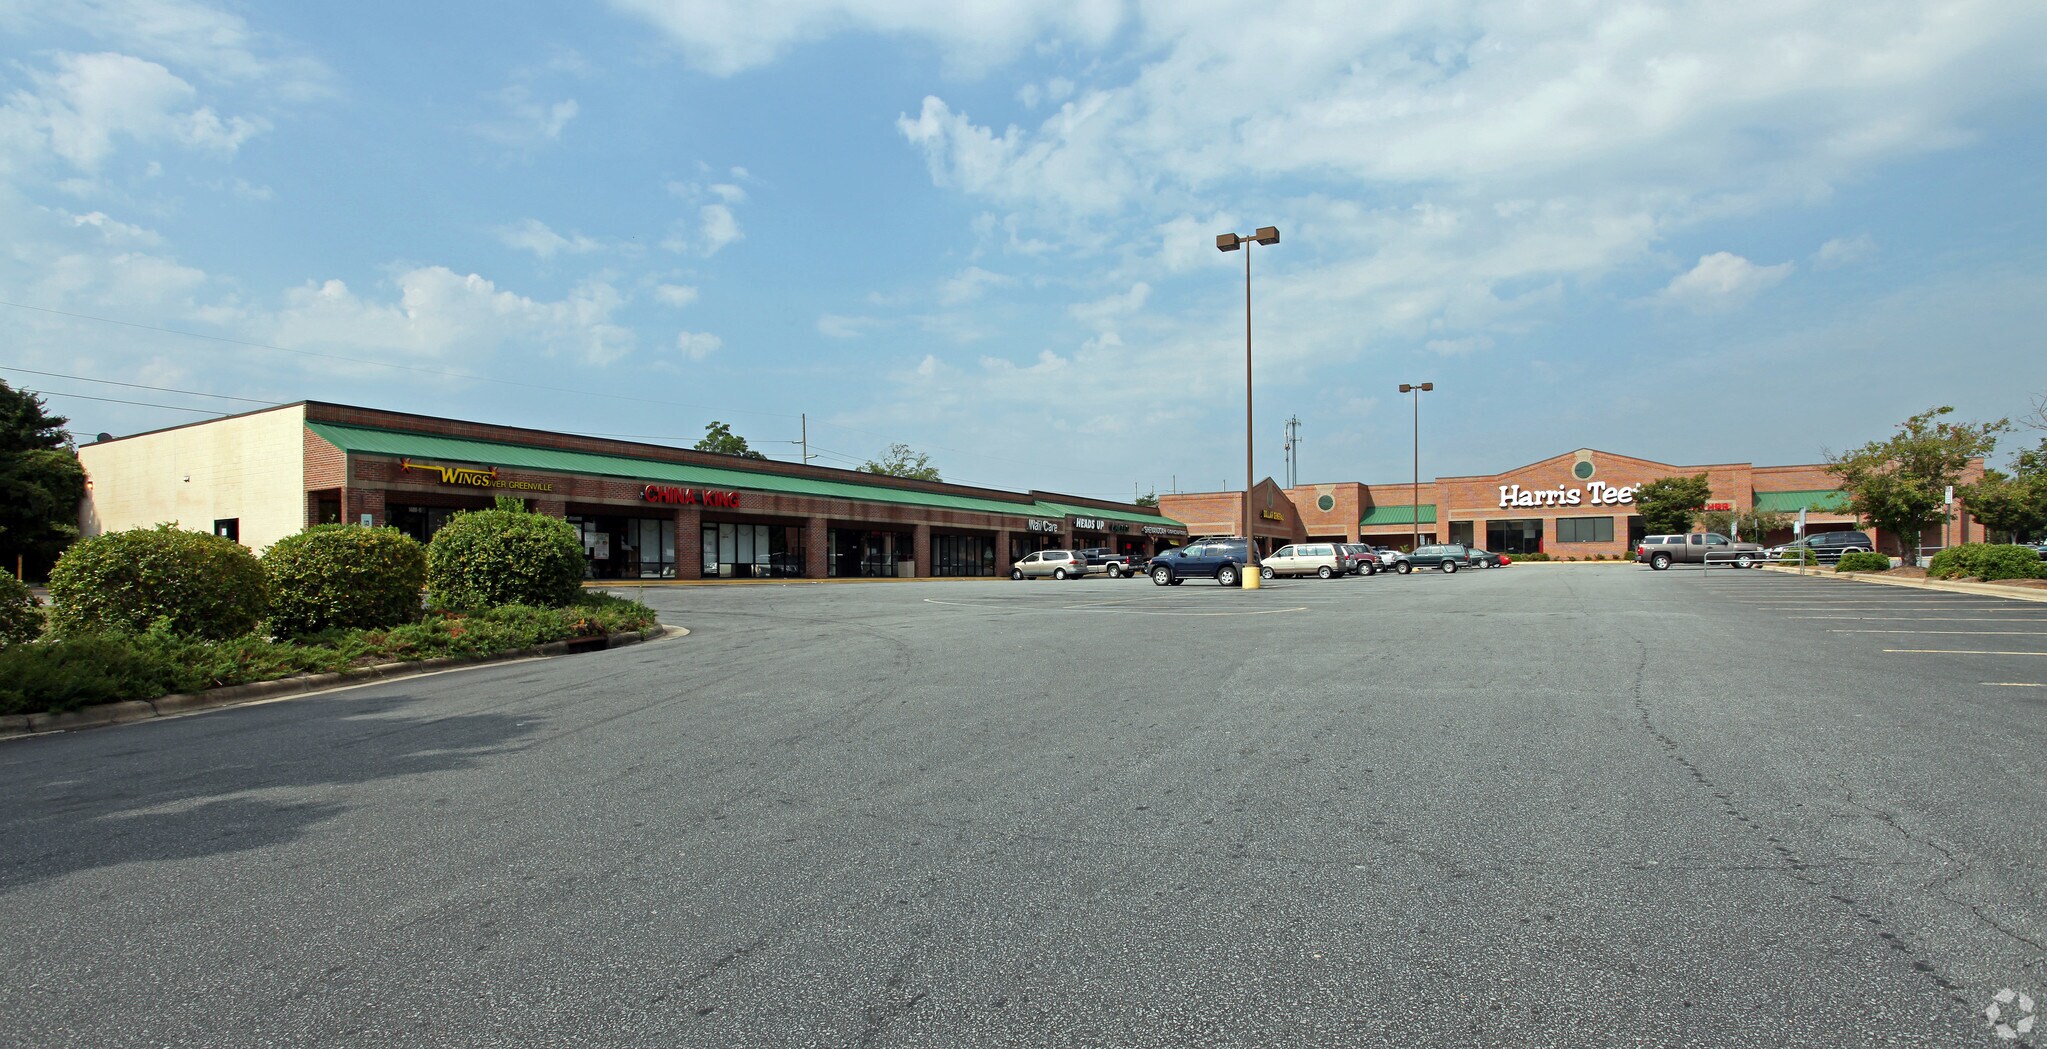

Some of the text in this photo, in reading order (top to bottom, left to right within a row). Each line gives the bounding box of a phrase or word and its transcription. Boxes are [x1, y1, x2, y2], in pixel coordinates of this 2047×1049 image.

[440, 466, 490, 486] WINGS
[508, 482, 552, 491] GREENVILLE
[1499, 481, 1642, 507] Harris Tee
[645, 485, 740, 508] CHINA KING
[1042, 520, 1058, 532] Care
[1076, 518, 1095, 529] HEADS
[1096, 520, 1105, 530] UP
